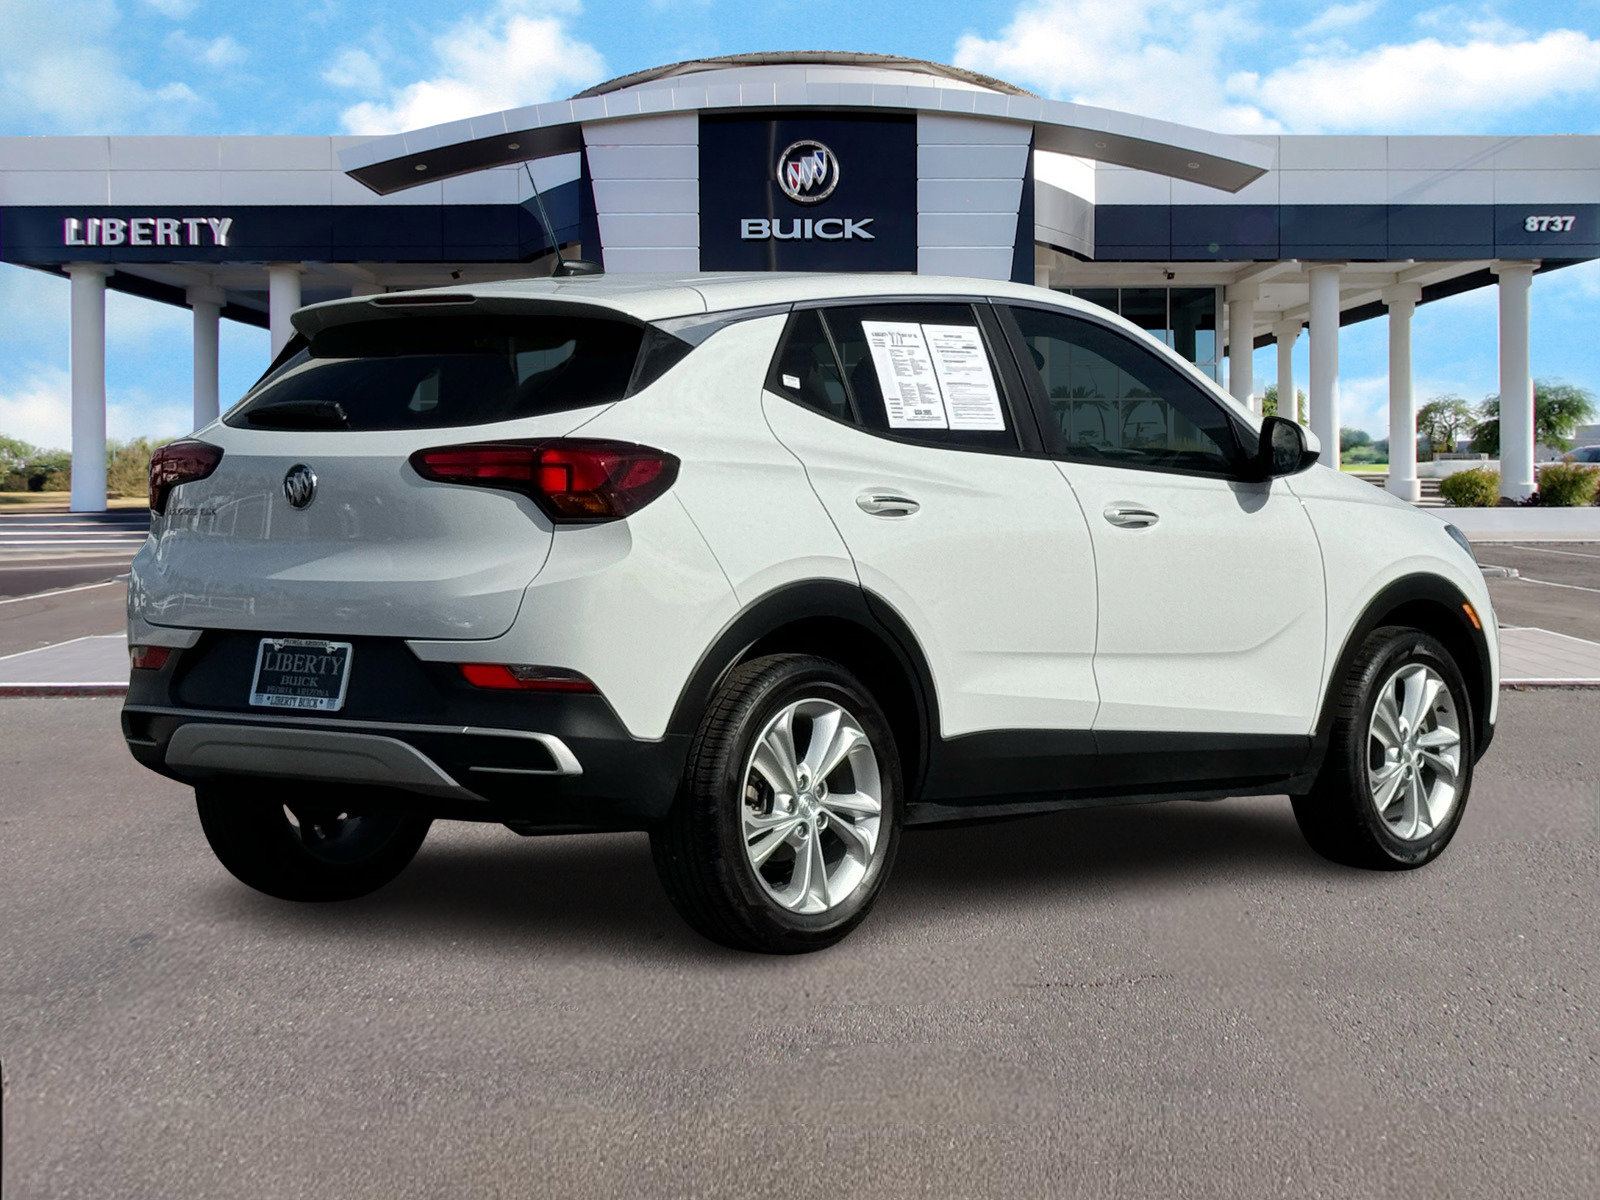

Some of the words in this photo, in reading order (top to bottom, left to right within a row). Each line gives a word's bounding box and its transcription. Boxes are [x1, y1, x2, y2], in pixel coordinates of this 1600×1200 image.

[64, 217, 233, 247] LIBERTY
[740, 218, 876, 240] BUICK
[1524, 215, 1576, 232] 8737
[263, 652, 345, 676] LIBERTY
[280, 675, 319, 688] BUICK
